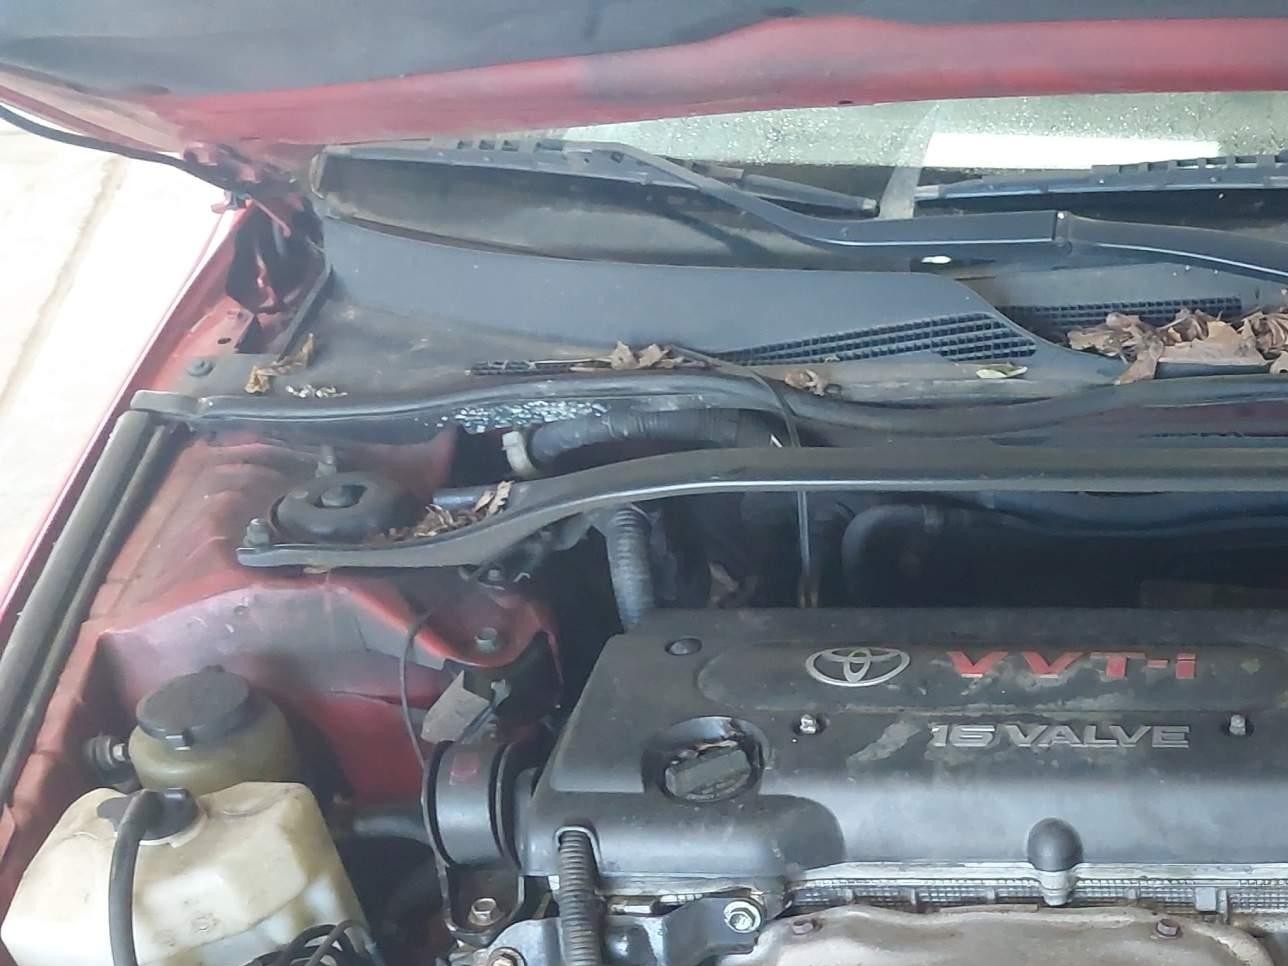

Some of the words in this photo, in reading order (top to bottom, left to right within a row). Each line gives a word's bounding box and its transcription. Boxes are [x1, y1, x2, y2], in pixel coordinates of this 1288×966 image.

[947, 649, 1197, 680] VVT-i
[931, 723, 997, 749] 16
[1004, 724, 1190, 748] VALVE
